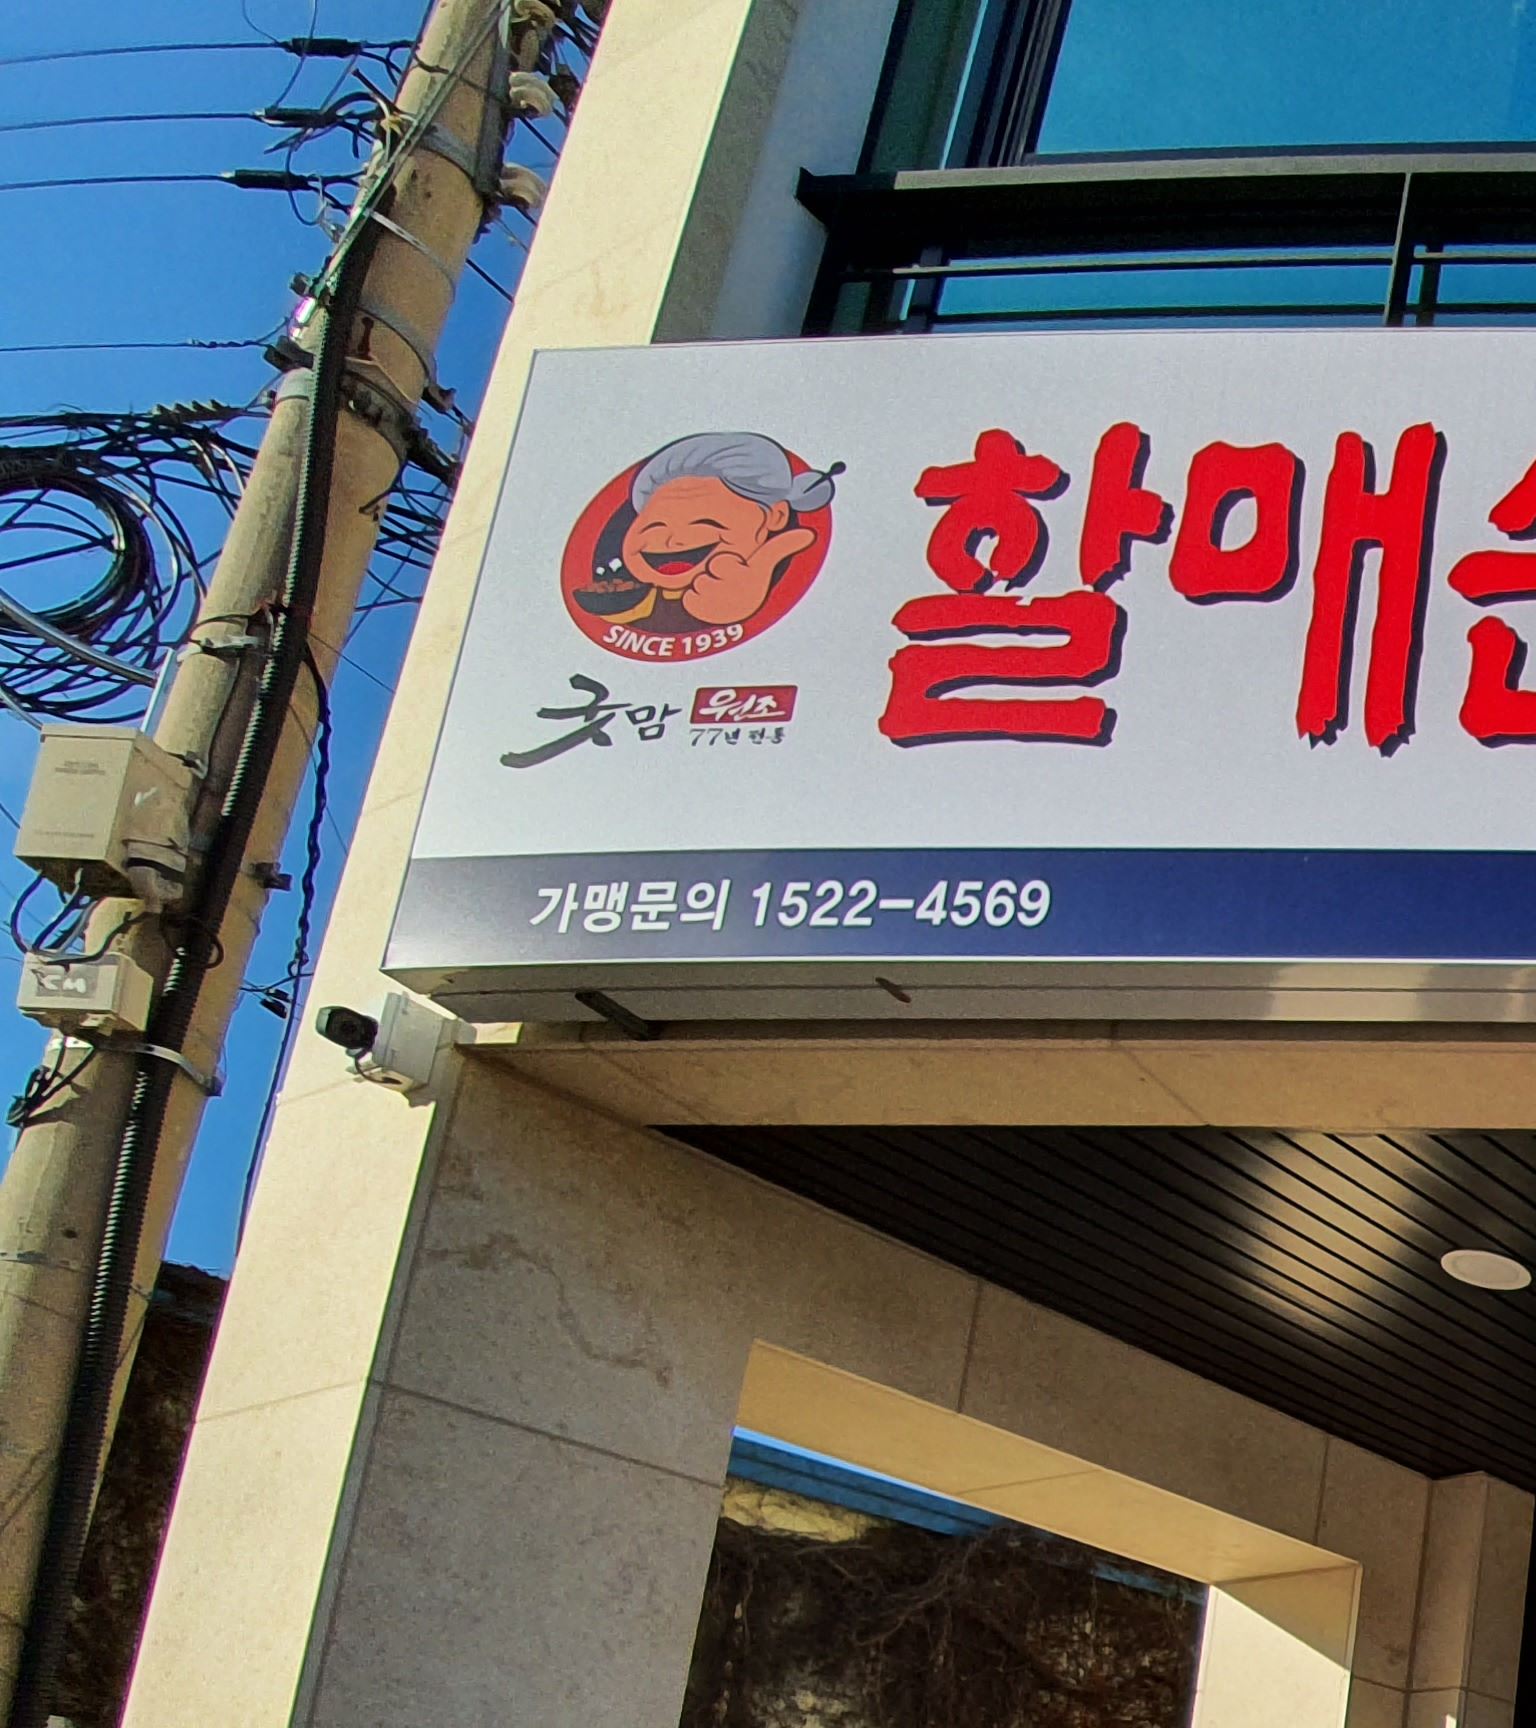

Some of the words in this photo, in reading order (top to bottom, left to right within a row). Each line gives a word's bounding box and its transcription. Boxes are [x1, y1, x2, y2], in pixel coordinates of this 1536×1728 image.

[603, 625, 675, 657] SINCE
[682, 624, 744, 655] 1939
[530, 879, 731, 933] 가맹문의
[751, 880, 1051, 927] 1522-4569
